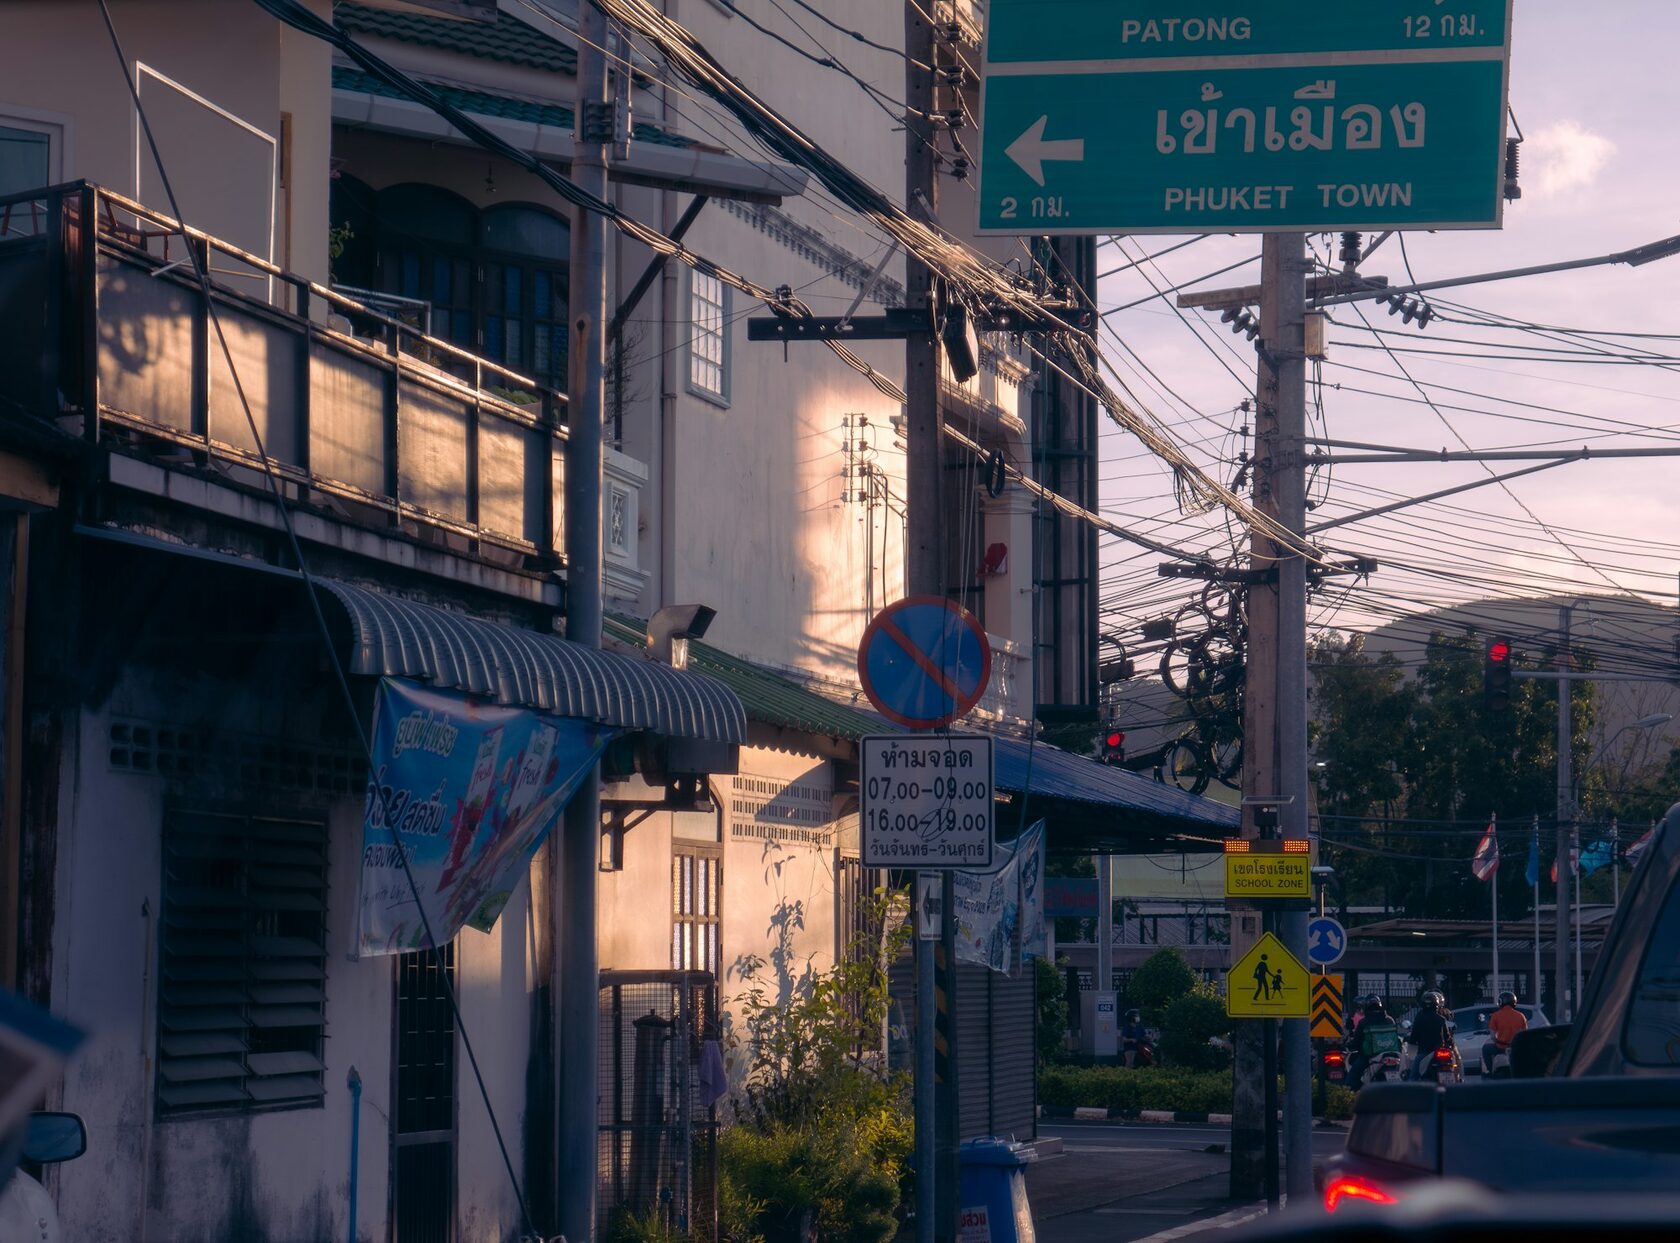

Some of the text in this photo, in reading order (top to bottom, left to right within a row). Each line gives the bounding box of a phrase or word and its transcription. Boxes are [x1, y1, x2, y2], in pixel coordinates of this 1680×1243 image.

[1122, 17, 1252, 43] PATONG
[1403, 14, 1486, 38] 12 กม.
[1155, 79, 1426, 155] เข้าเมือง
[1000, 195, 1071, 218] 2 กม.
[1165, 182, 1413, 211] PHUKET TOWN
[881, 741, 974, 769] ห้ามจอด
[868, 775, 986, 800] 07.00-09.00
[868, 808, 986, 832] 16.00-19.00
[870, 838, 986, 864] วันจันทร์-วันศุกร์
[1233, 859, 1304, 876] เขตโรงเรียน
[1235, 878, 1304, 888] SCHOOL ZONE
